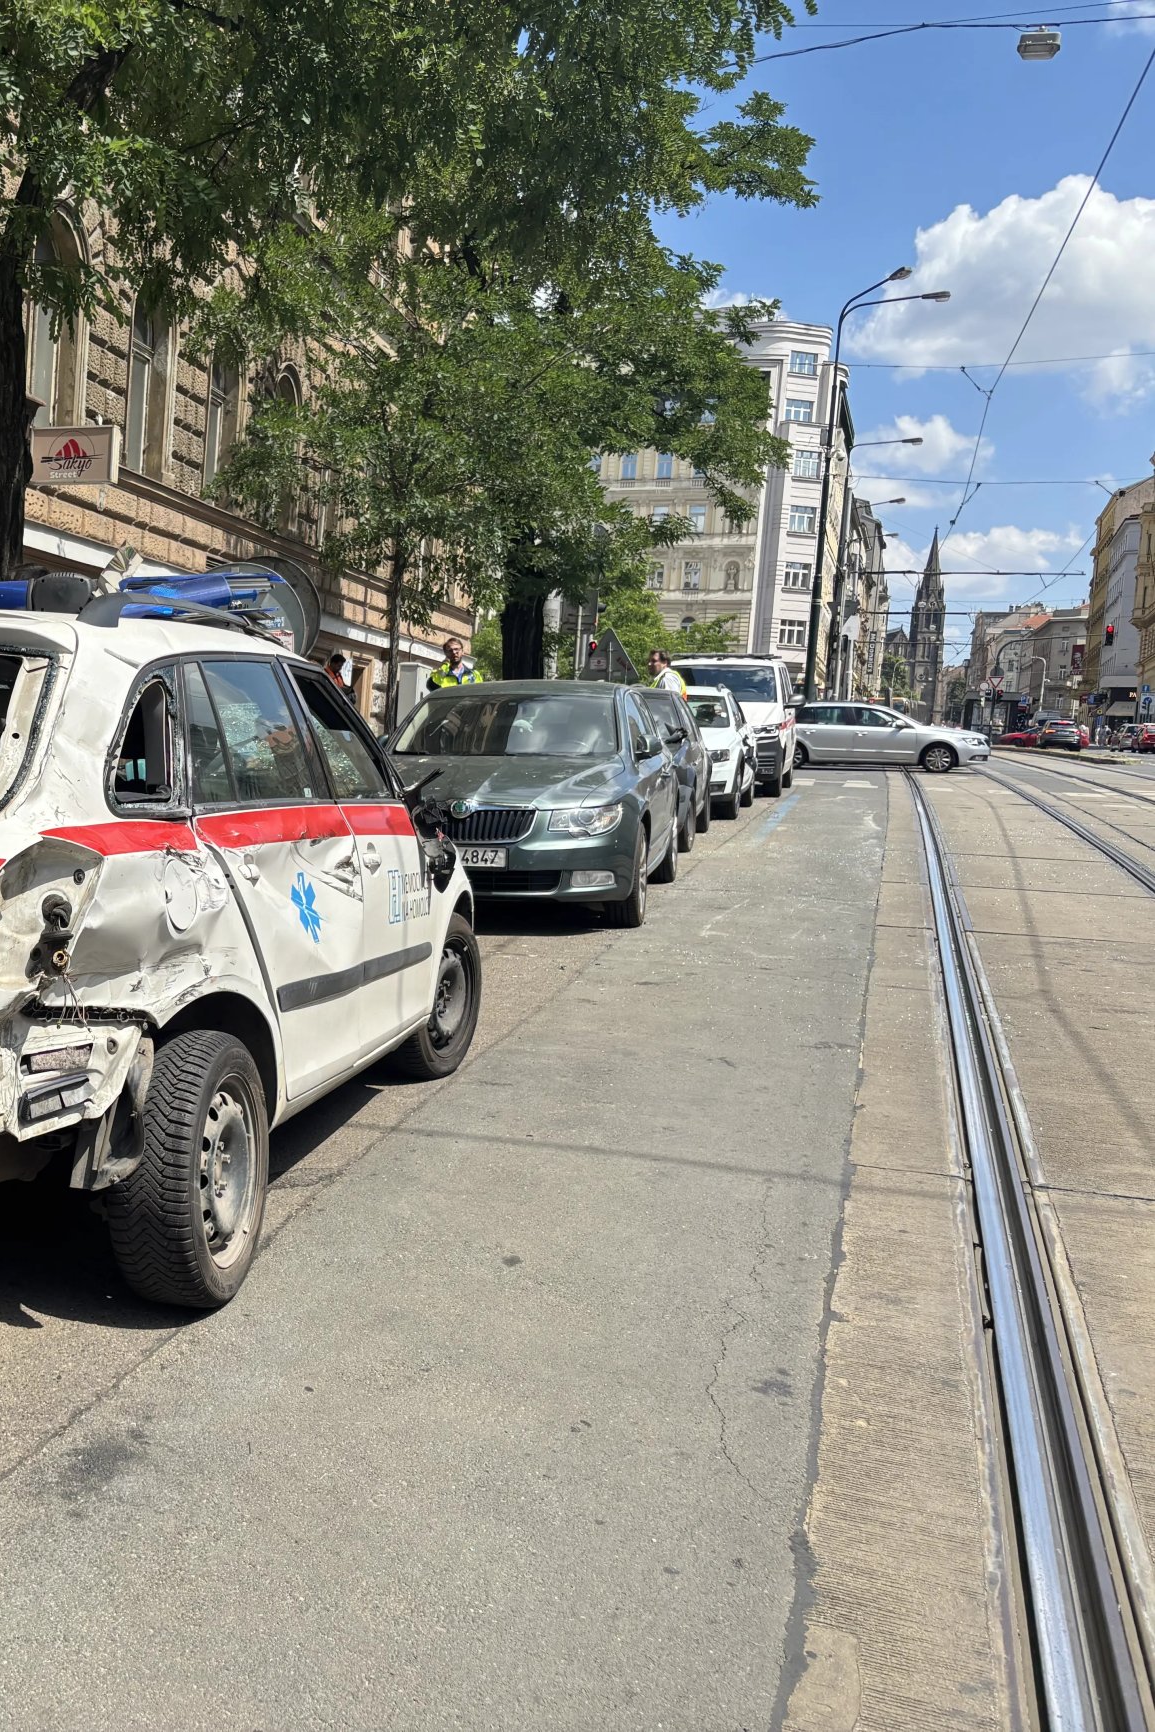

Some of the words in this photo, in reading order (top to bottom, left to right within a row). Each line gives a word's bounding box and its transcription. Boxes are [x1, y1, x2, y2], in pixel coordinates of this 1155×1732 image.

[48, 455, 93, 477] Sakyo
[49, 471, 77, 479] Street
[461, 849, 499, 865] 4847
